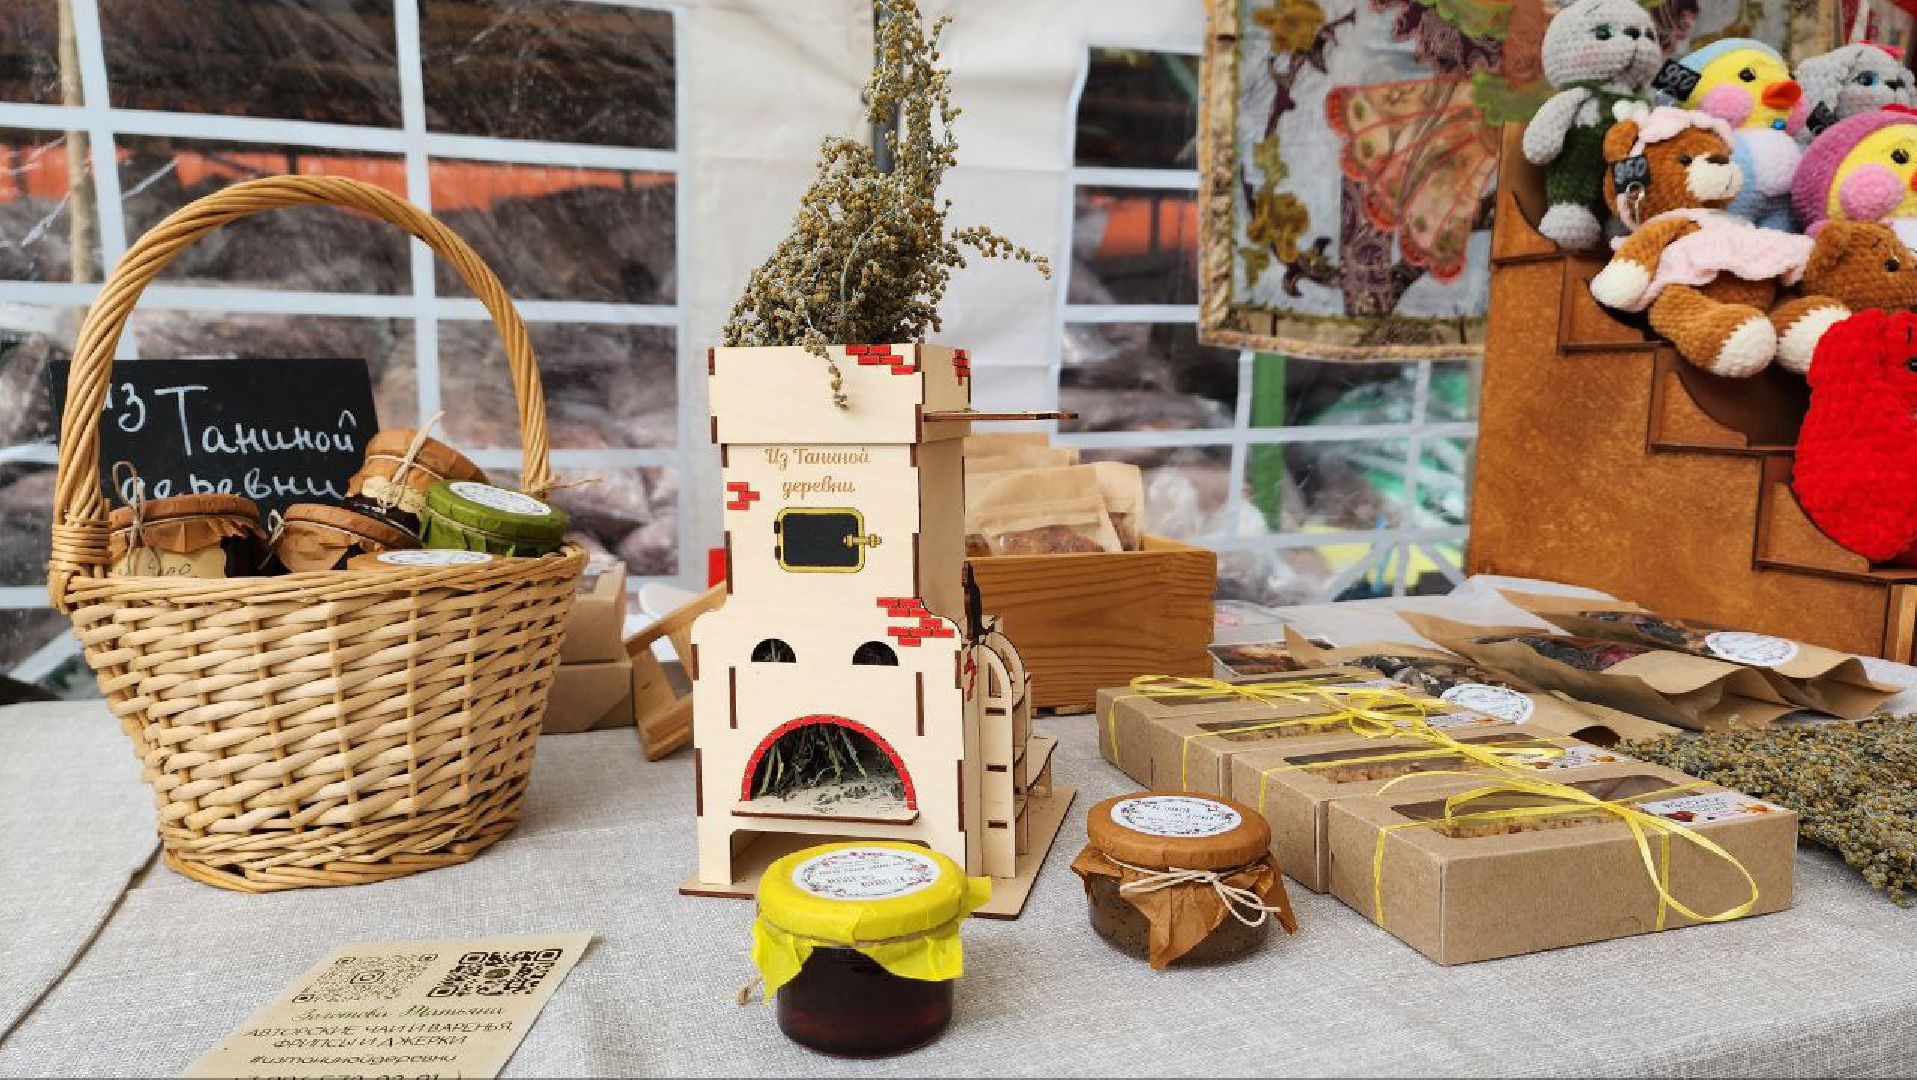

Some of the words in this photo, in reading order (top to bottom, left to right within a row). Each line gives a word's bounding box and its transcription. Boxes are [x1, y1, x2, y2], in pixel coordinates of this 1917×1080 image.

[154, 385, 357, 457] Таниной
[764, 447, 789, 471] Из
[792, 446, 871, 465] Таниной
[782, 475, 856, 500] деревни
[244, 1025, 362, 1037] АВТОРСКИЕ
